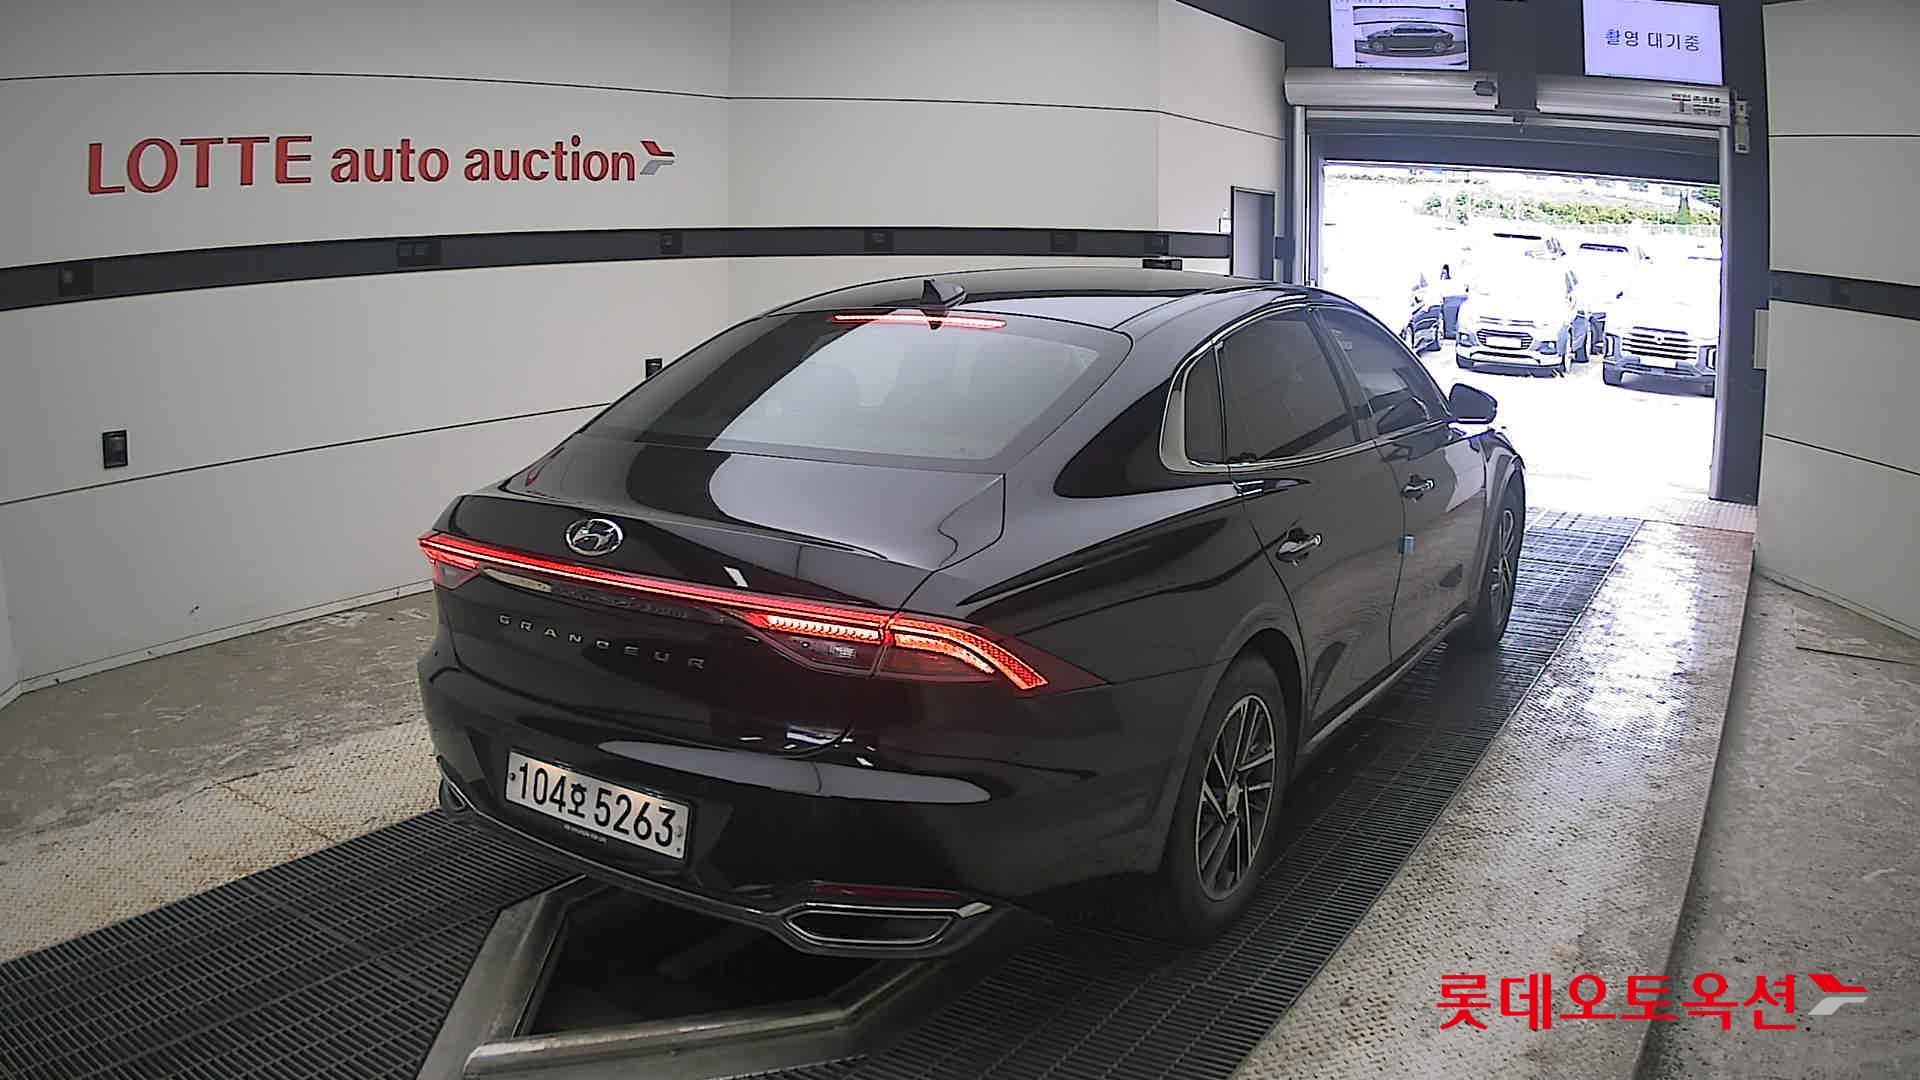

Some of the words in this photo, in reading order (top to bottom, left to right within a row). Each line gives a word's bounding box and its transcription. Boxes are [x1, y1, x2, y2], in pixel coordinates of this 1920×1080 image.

[1647, 32, 1700, 52] 대기중
[88, 135, 312, 195] LOTTE
[330, 138, 449, 183] auto
[463, 135, 636, 181] auction
[498, 614, 705, 669] GRANDEUR
[520, 762, 587, 818] 104호
[594, 786, 676, 847] 5263
